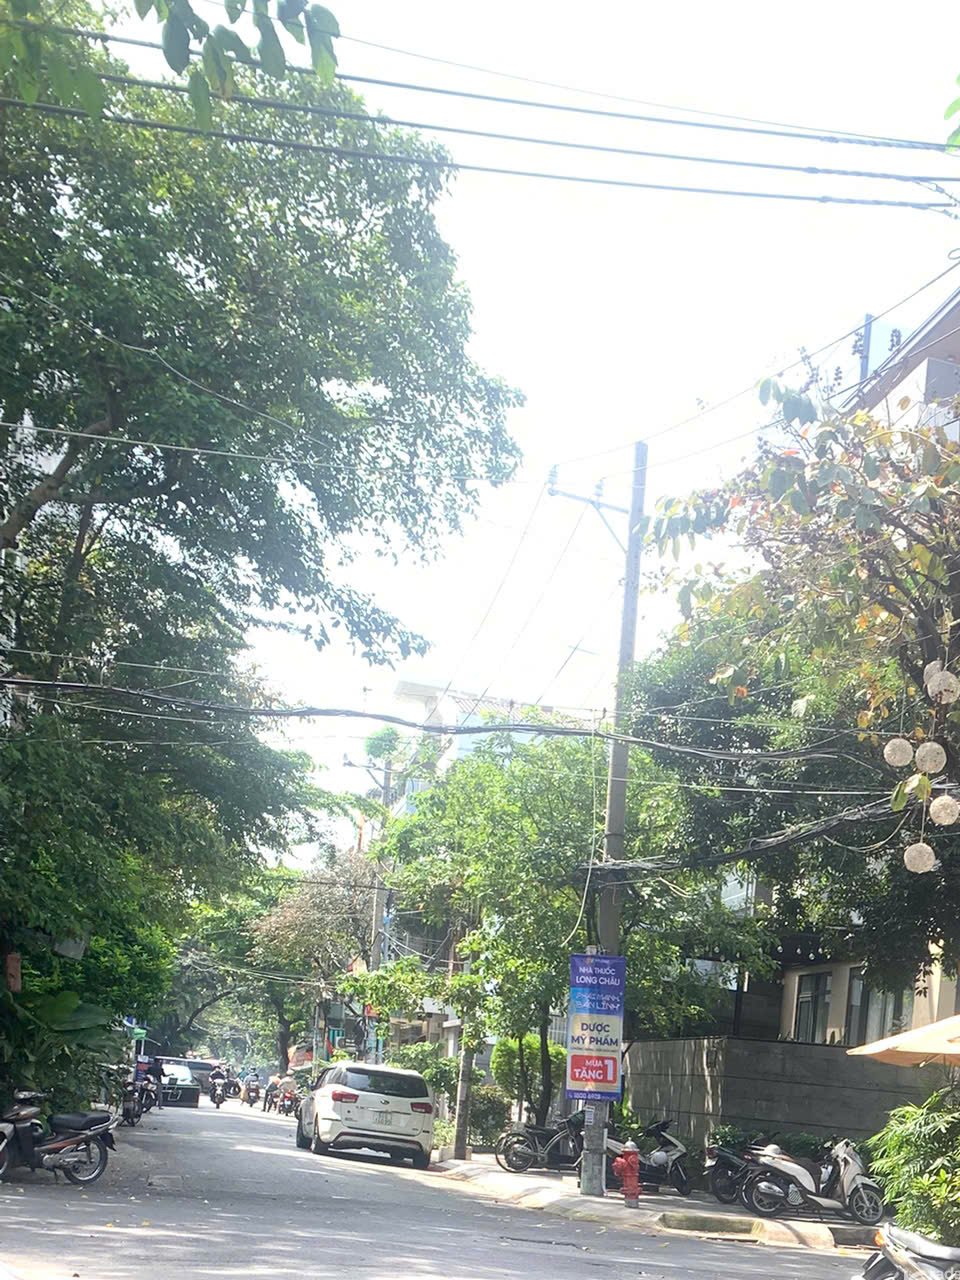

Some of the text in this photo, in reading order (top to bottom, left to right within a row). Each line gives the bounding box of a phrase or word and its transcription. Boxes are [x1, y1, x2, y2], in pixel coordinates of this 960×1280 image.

[594, 965, 616, 976] THUỐC
[575, 975, 621, 986] LONG CHÂU
[581, 1021, 610, 1034] DƯỢC
[589, 1033, 619, 1047] PHẨM
[585, 1059, 603, 1068] MUA
[604, 1059, 614, 1082] 1
